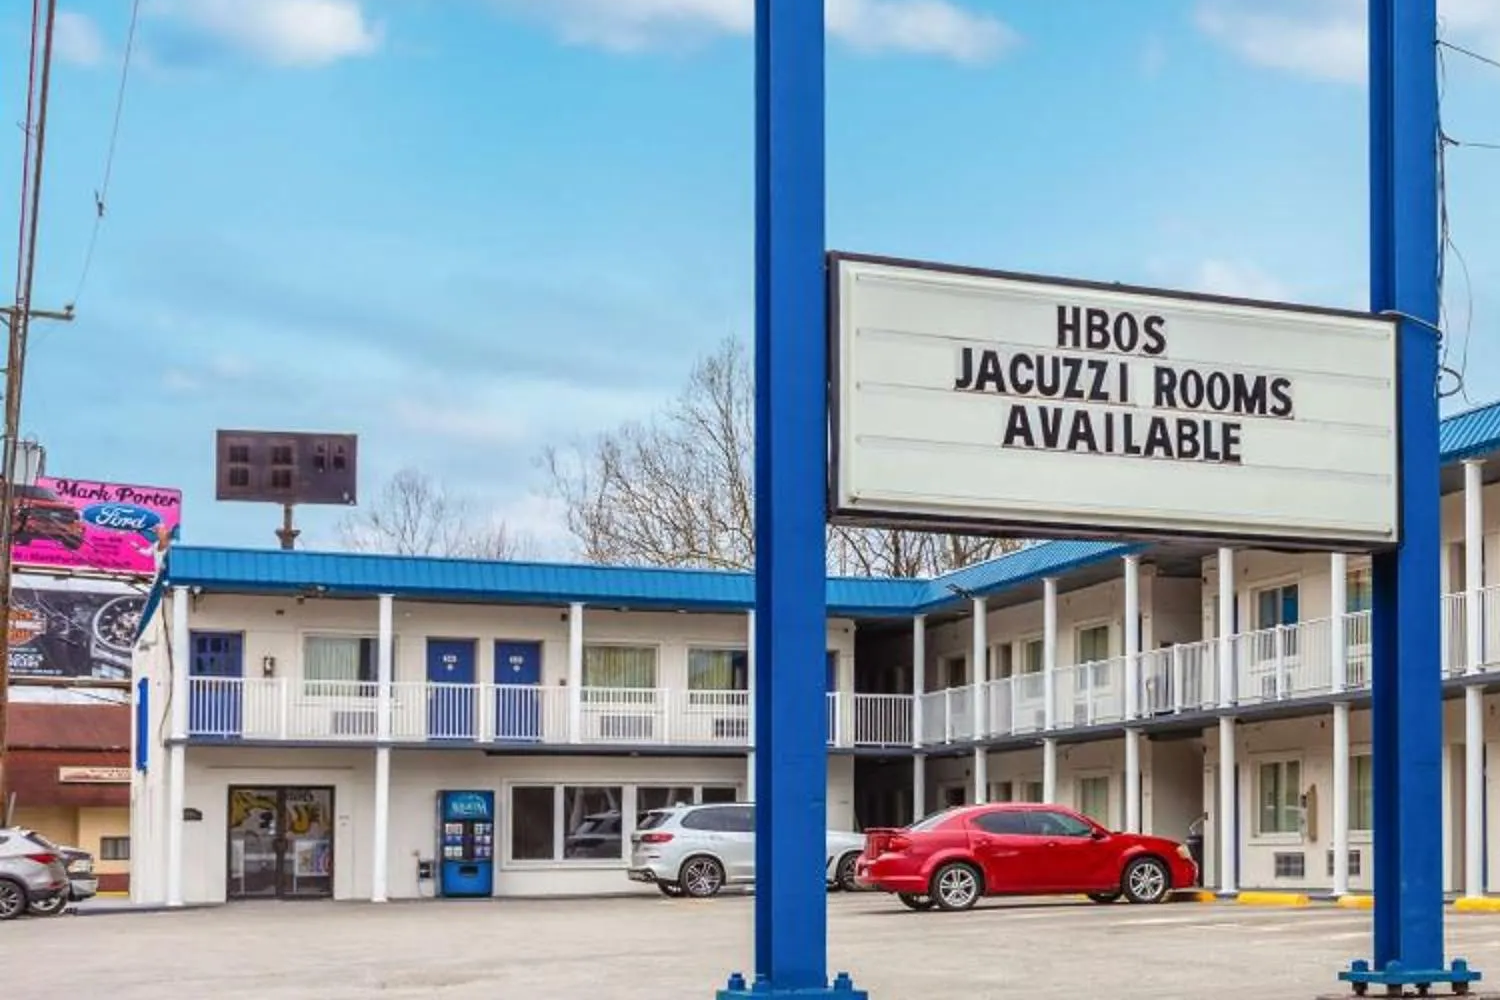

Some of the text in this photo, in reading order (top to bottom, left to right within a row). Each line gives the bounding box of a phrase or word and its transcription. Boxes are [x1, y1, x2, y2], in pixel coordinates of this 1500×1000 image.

[1057, 305, 1166, 355] HBOS
[954, 347, 1293, 416] JACUZZI ROOMS
[1003, 405, 1242, 462] AVAILABLE
[56, 480, 180, 506] Mark Porter
[96, 507, 147, 529] Ford
